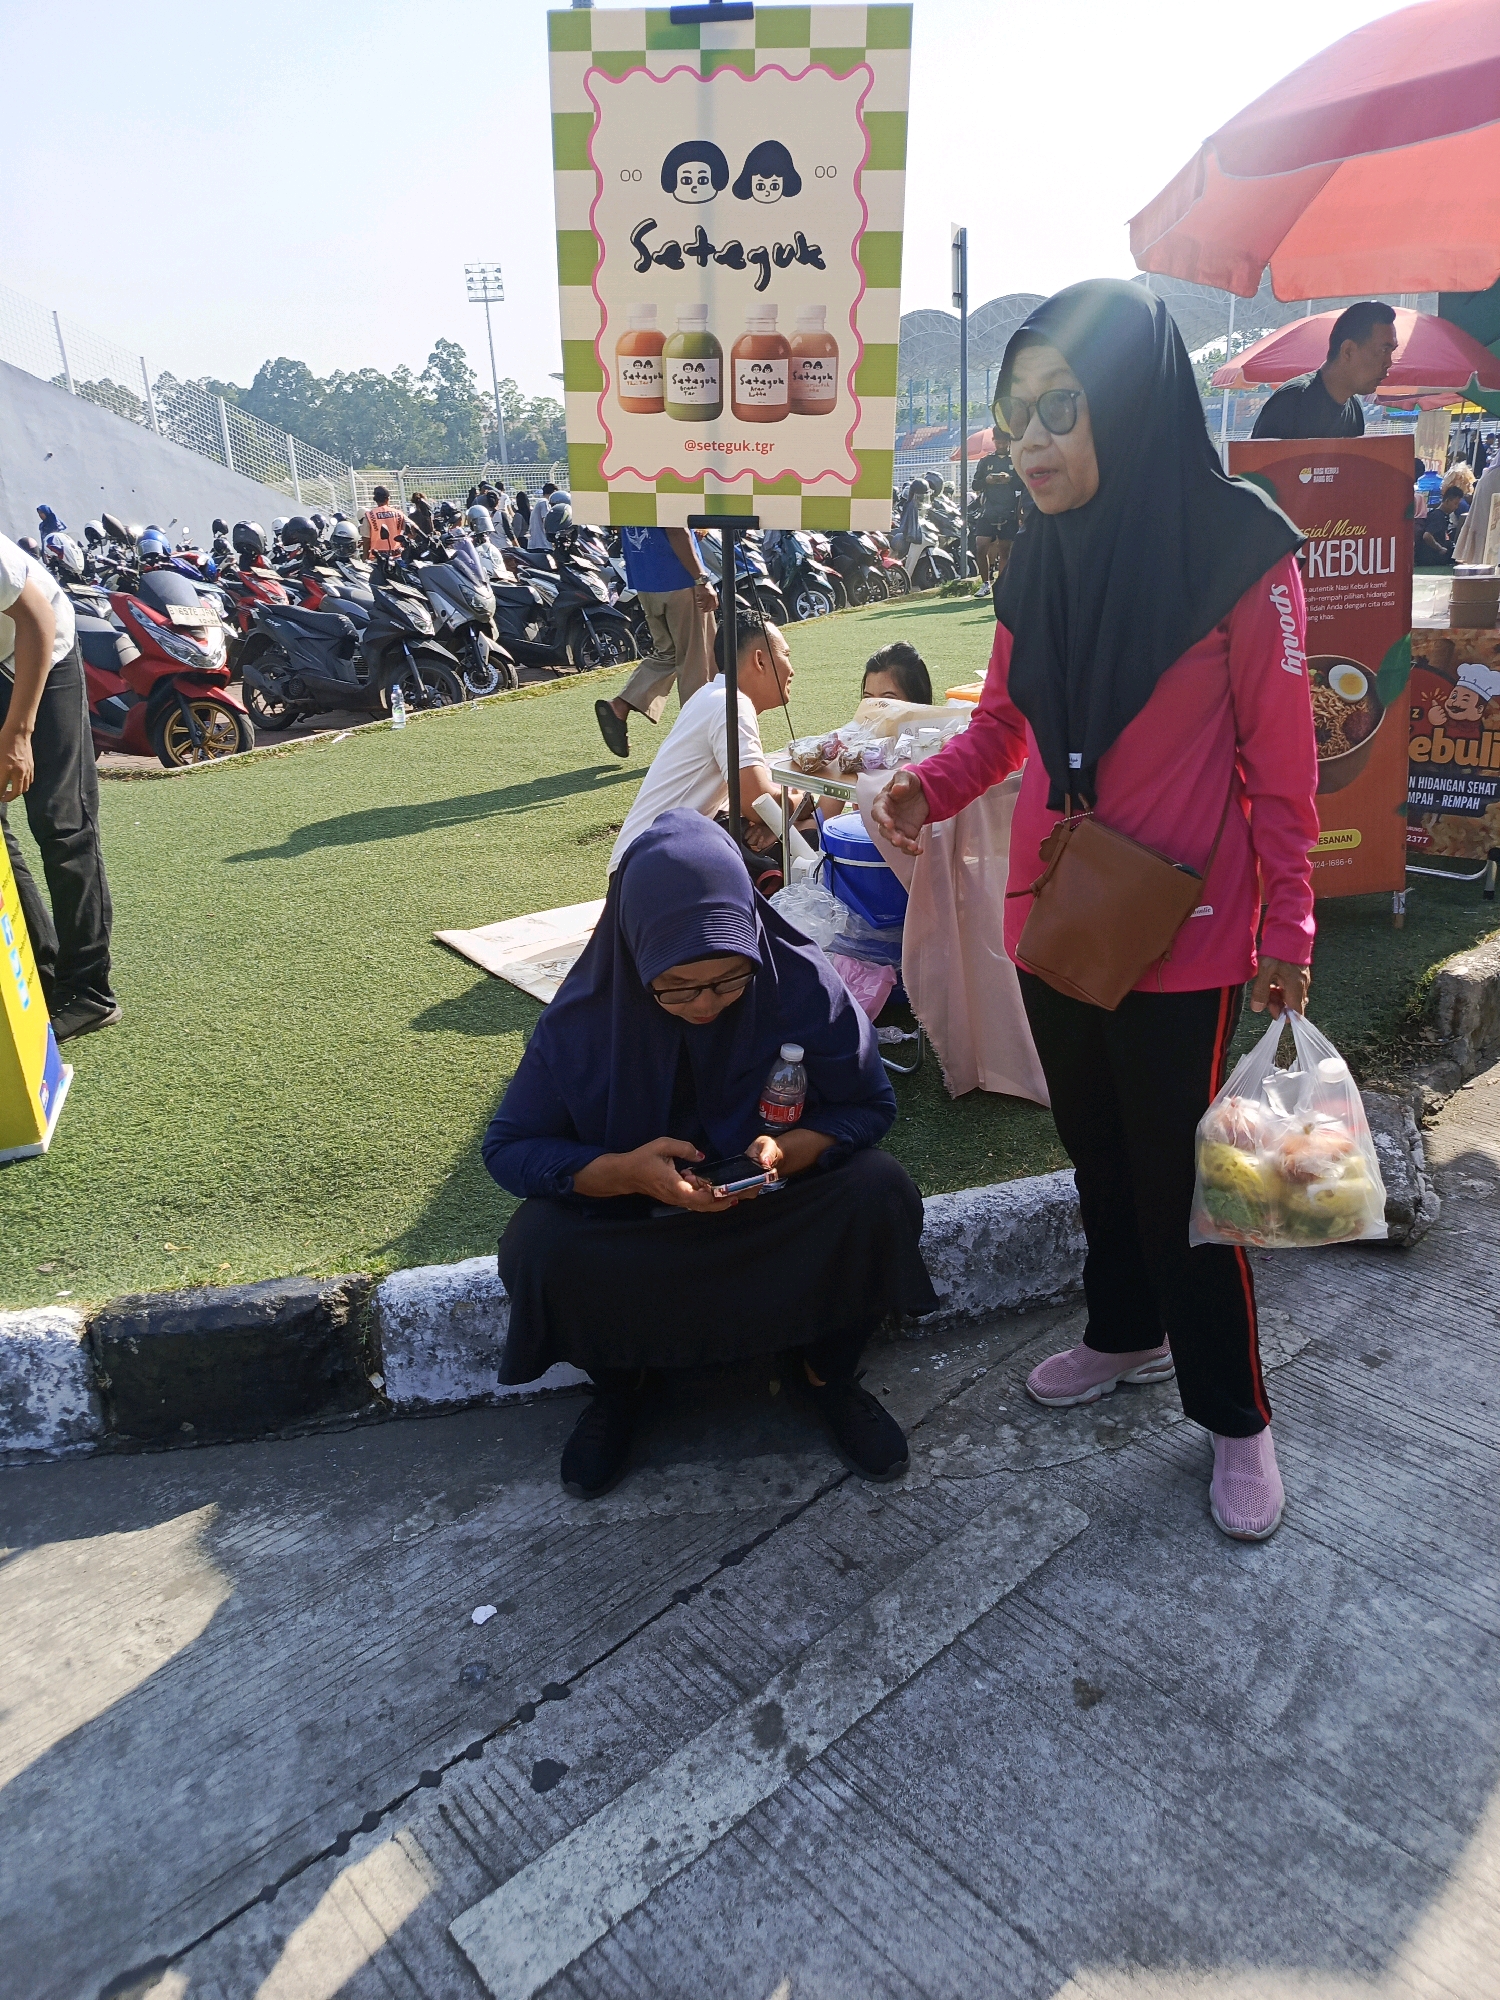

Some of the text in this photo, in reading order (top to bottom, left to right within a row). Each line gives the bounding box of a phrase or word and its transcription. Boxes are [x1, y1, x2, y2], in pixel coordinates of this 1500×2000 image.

[629, 217, 827, 292] Seteguk
[684, 439, 775, 455] @seteguk.tgr
[1329, 519, 1367, 539] Menu
[1308, 536, 1396, 578] KEBULI
[1308, 584, 1334, 593] autentik
[1335, 583, 1349, 591] Nasi
[1350, 582, 1369, 590] Kebuli
[1366, 591, 1395, 599] hidangan
[1344, 602, 1367, 610] dengan
[1268, 583, 1307, 677] sporty
[1408, 727, 1500, 768] ebuli
[1417, 776, 1466, 793] HIDANGAN
[1466, 780, 1498, 796] SEHAT
[1407, 791, 1434, 806] MPAH
[1441, 794, 1481, 810] REMPAH
[1318, 834, 1353, 845] ESANAN
[1406, 834, 1429, 844] 2377
